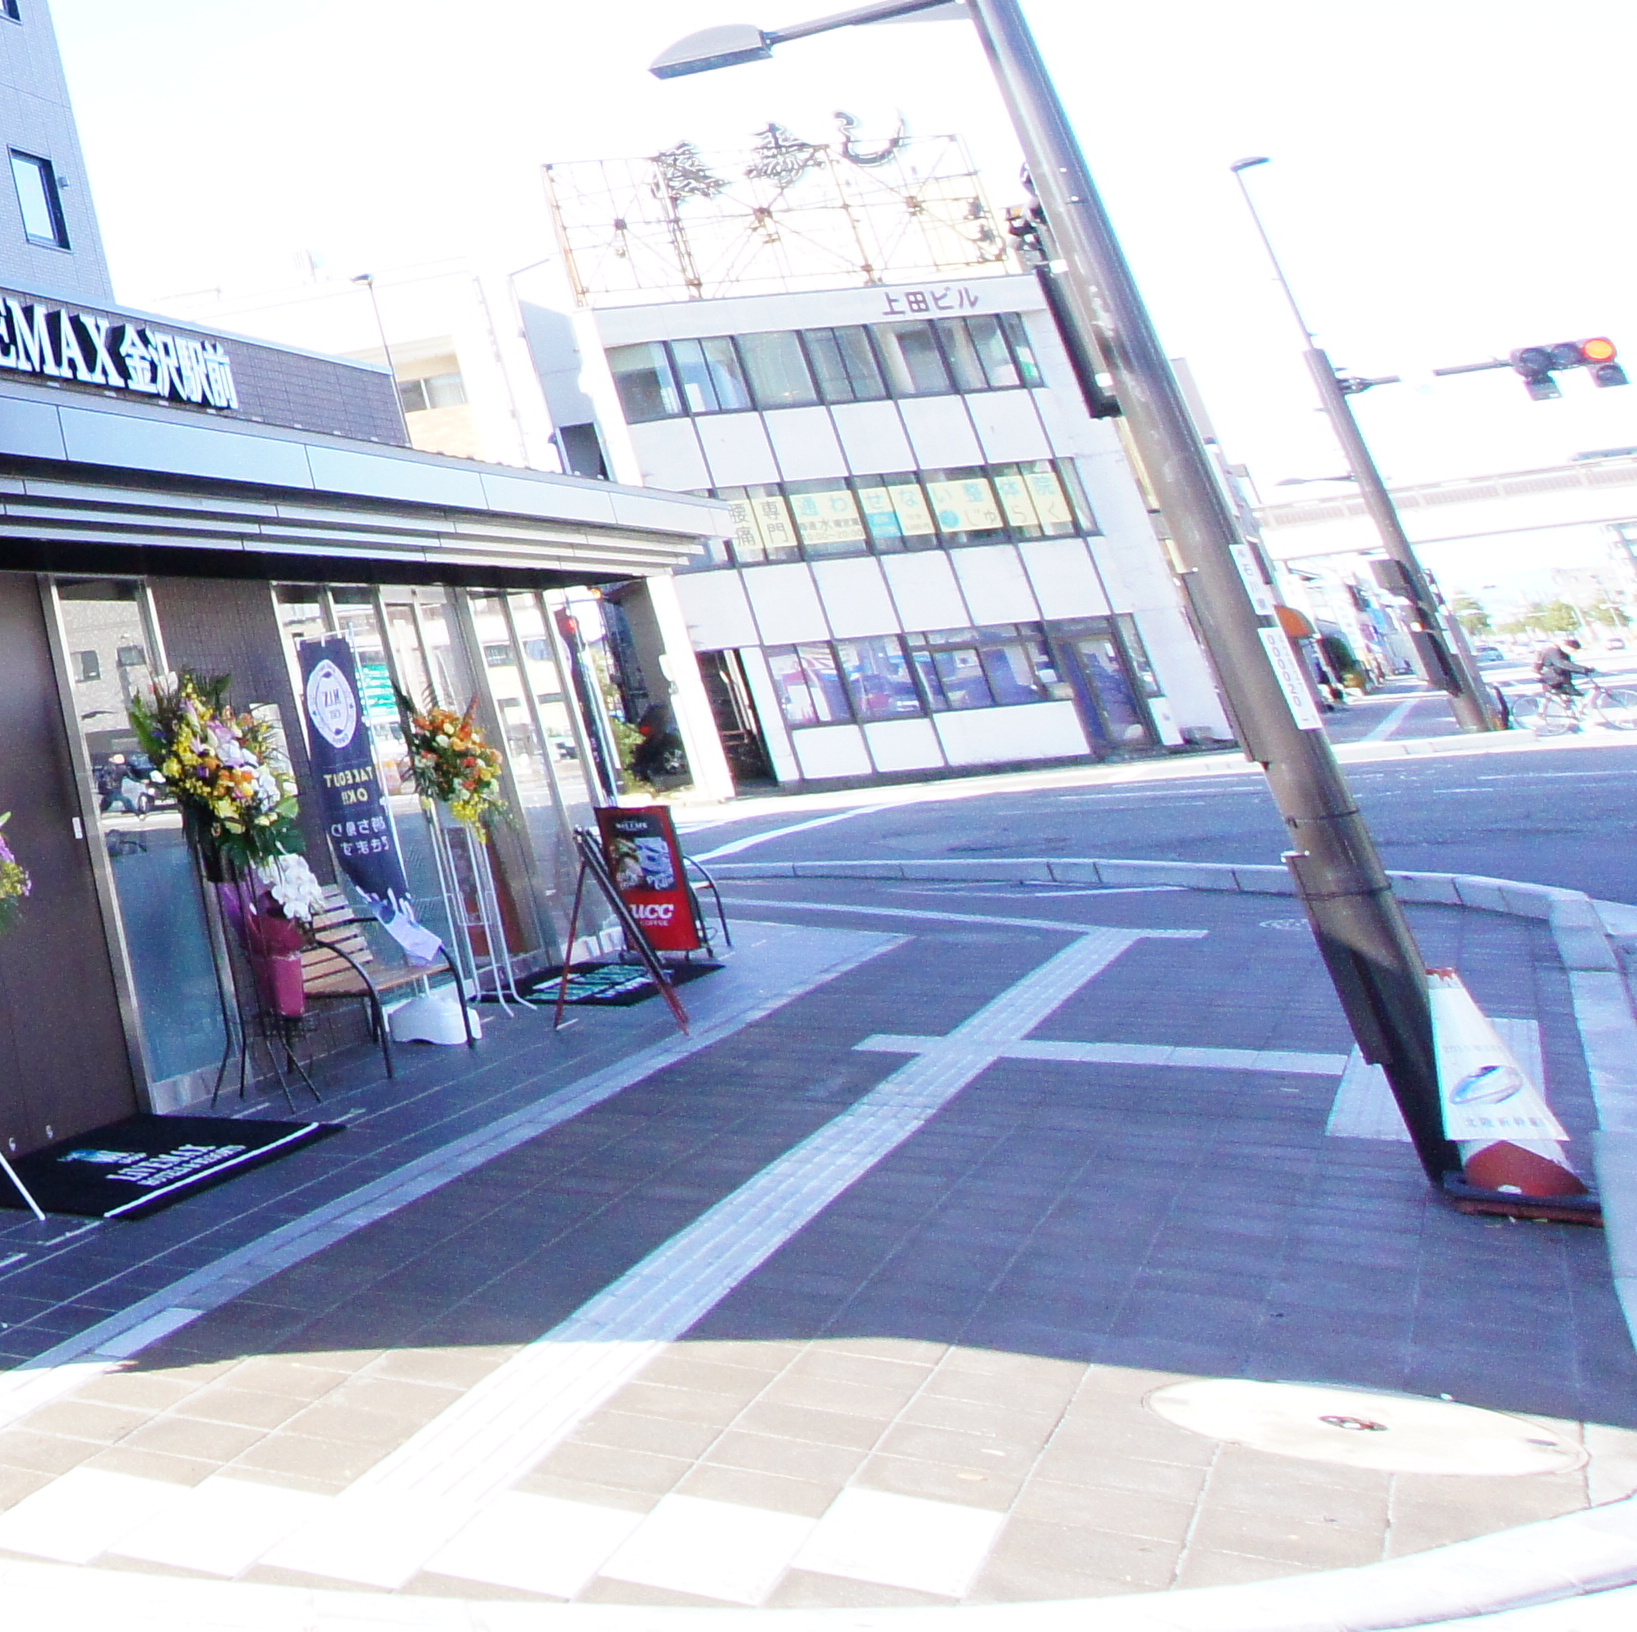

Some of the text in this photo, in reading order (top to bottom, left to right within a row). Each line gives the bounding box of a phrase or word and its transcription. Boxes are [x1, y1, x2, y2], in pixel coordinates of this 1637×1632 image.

[881, 285, 980, 316] 上田ビル
[118, 321, 239, 410] 金沢駅前
[761, 499, 789, 544] 専門
